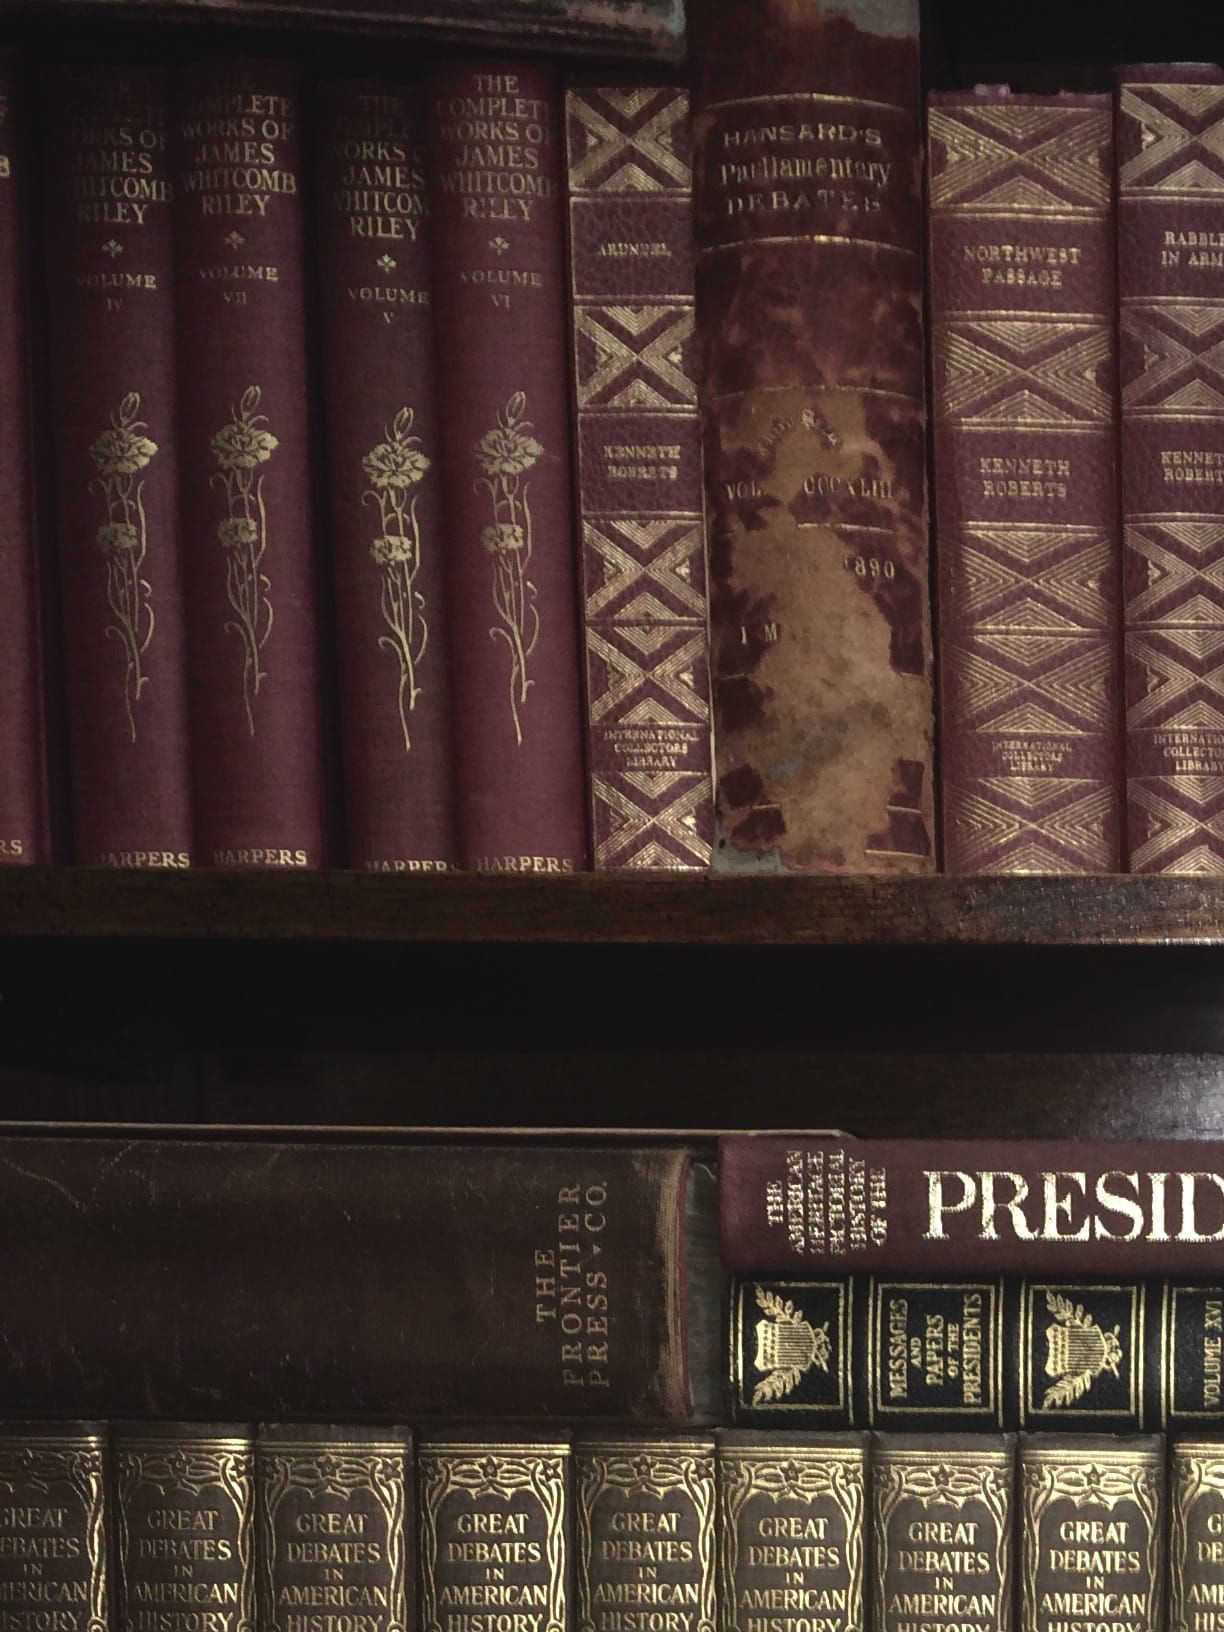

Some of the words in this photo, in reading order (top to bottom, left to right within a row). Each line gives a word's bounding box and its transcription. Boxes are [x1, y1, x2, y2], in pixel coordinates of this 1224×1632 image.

[473, 75, 519, 95] THE
[723, 123, 882, 147] HANSARD'S
[196, 142, 275, 165] JAMES
[457, 145, 539, 170] JAMES
[203, 194, 271, 218] RILEY
[963, 245, 1081, 266] NORTHWEST
[1160, 250, 1182, 266] IN
[981, 266, 1062, 287] PASSAGE
[979, 458, 1071, 476] KENNETH
[982, 479, 1069, 499] ROBERTS
[477, 856, 573, 874] HARPERS
[585, 1180, 609, 1234] CO.
[534, 1246, 557, 1324] THE
[559, 1183, 583, 1387] FRONTIER
[1204, 1299, 1223, 1327] XVI
[586, 1269, 610, 1388] PRESS
[946, 1322, 959, 1353] THE
[888, 1297, 909, 1400] MESSAGES
[911, 1335, 923, 1369] AND
[925, 1312, 945, 1388] PAPERS
[962, 1292, 982, 1408] PRESIDENTS
[946, 1357, 959, 1379] OF
[1203, 1330, 1223, 1409] VOLUME
[457, 1512, 529, 1534] GREAT
[446, 1541, 541, 1563] DEBATES
[485, 1568, 505, 1580] IN
[440, 1584, 548, 1607] AMERICAN
